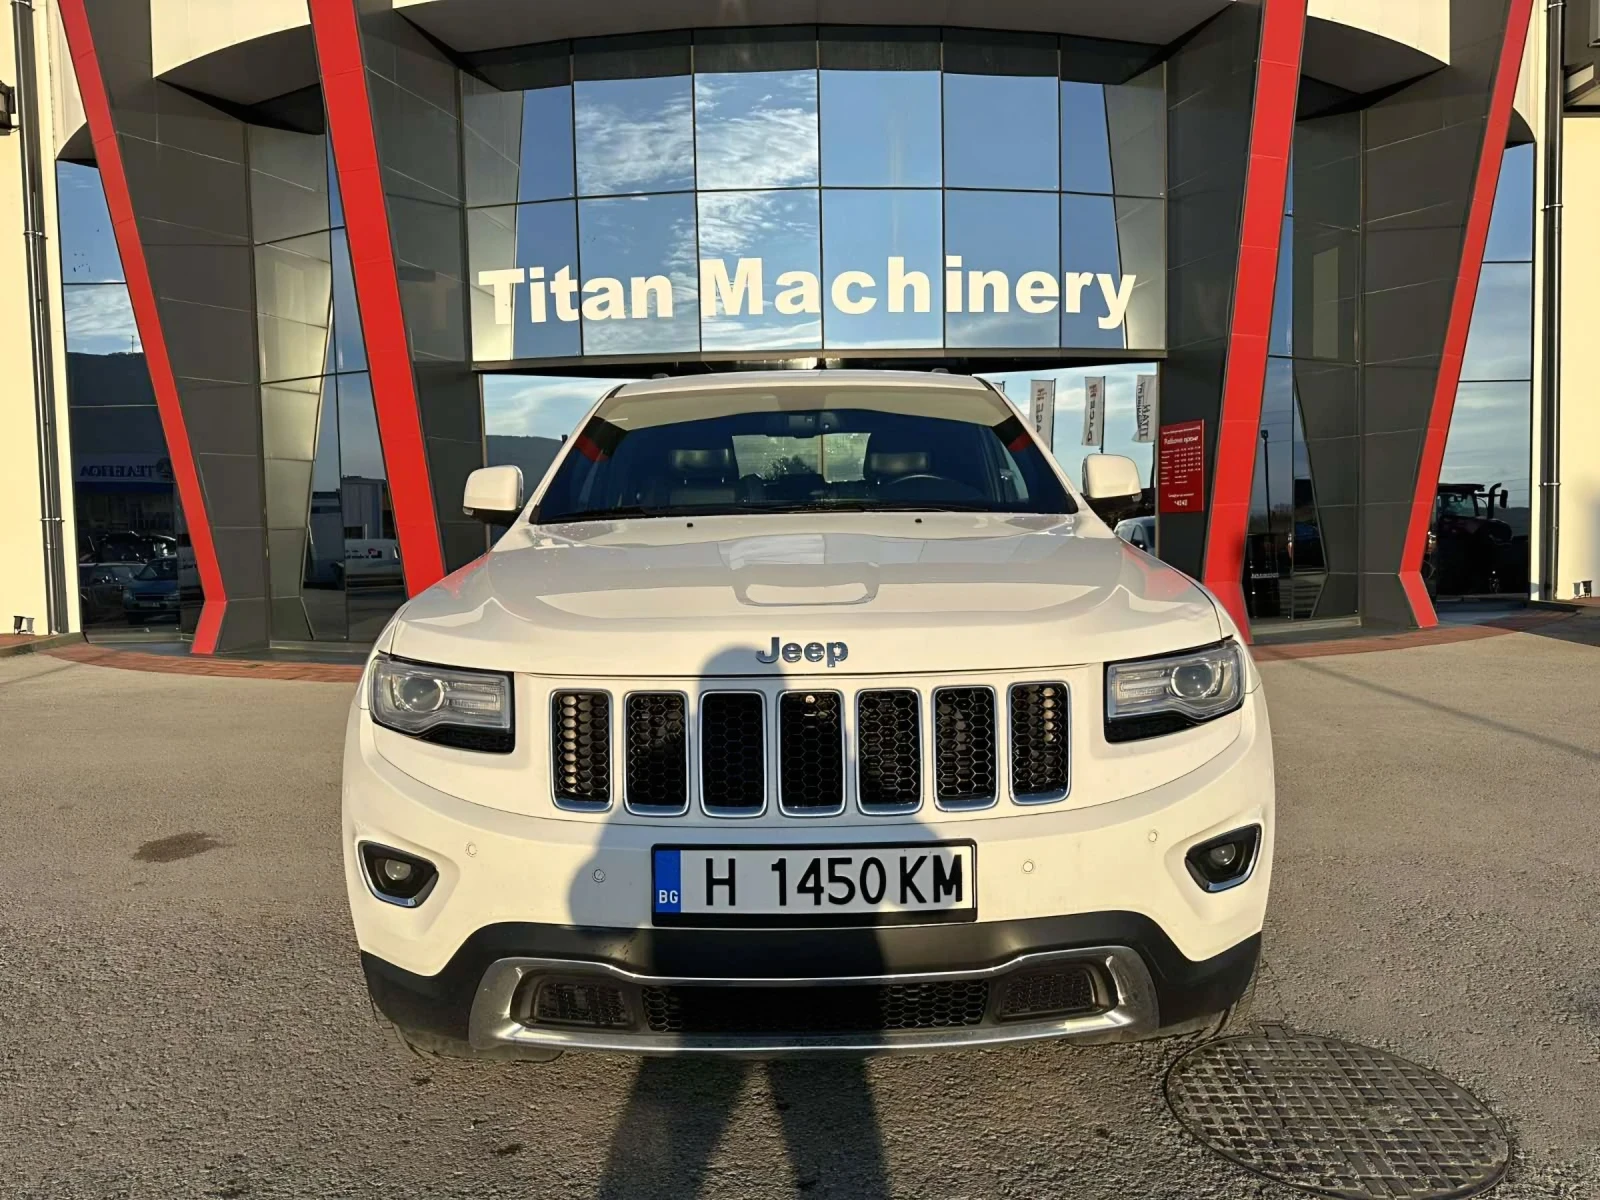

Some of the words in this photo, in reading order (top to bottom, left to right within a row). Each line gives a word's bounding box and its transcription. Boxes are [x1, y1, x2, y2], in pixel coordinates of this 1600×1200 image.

[478, 264, 674, 325] Titan
[699, 255, 1137, 330] Machinery
[755, 636, 848, 668] Jeep
[658, 889, 679, 904] BG
[705, 857, 736, 907] H
